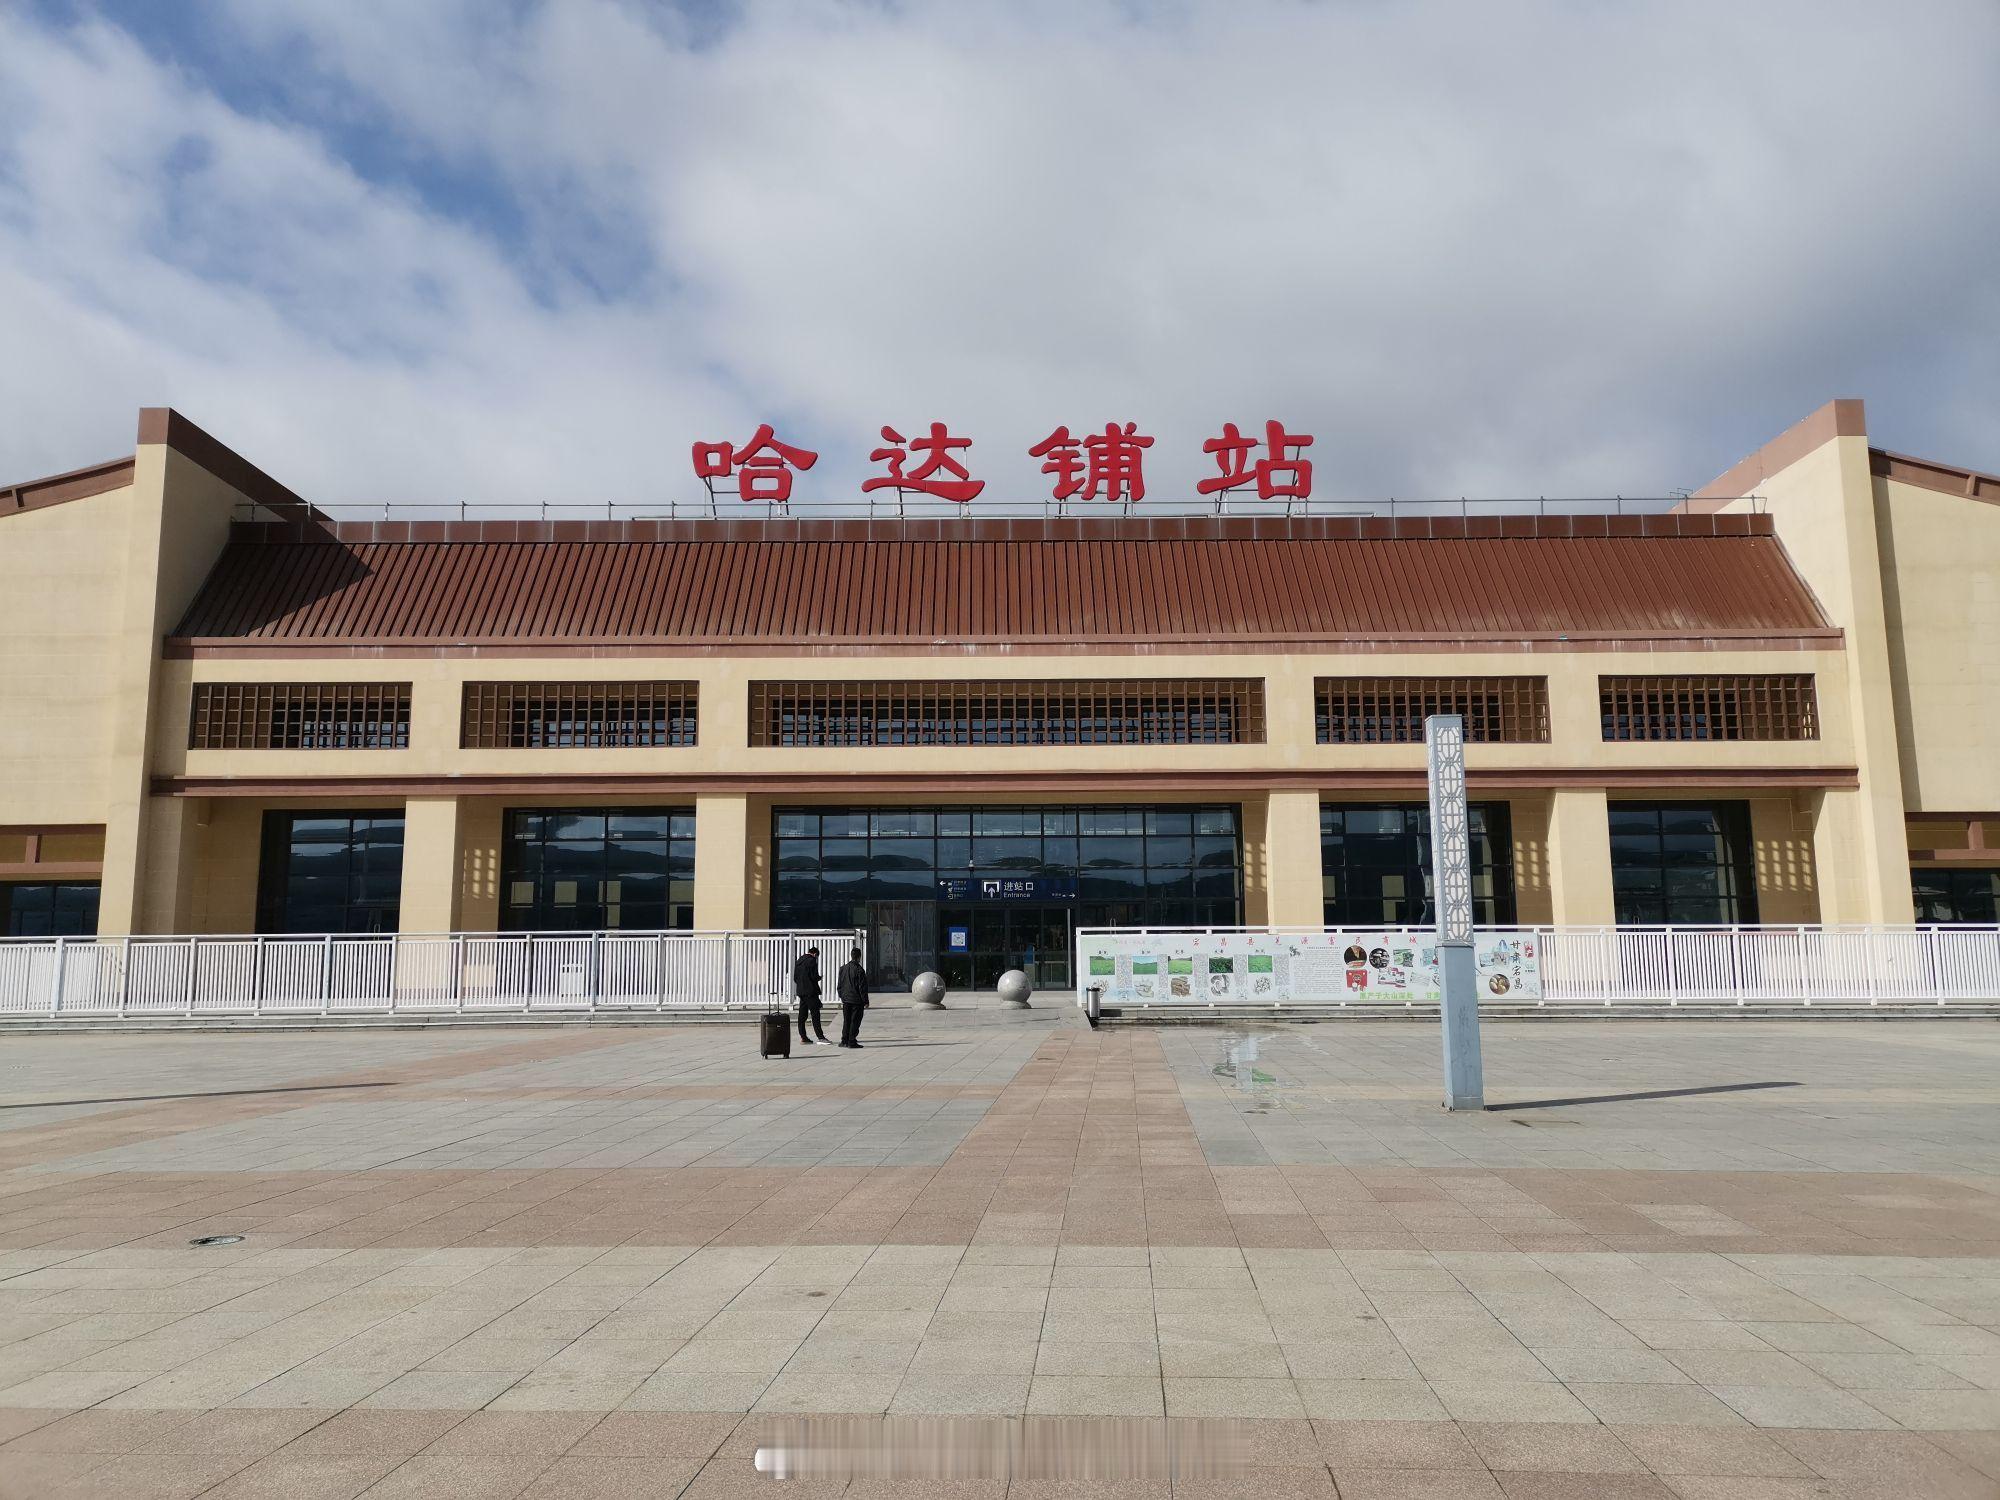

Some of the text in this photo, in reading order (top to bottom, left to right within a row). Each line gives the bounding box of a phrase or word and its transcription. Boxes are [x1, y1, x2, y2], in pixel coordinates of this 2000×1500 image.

[692, 420, 1314, 501] 哈达铺站
[1003, 881, 1034, 892] 进站口
[1510, 939, 1523, 990] 甘肃宕昌
